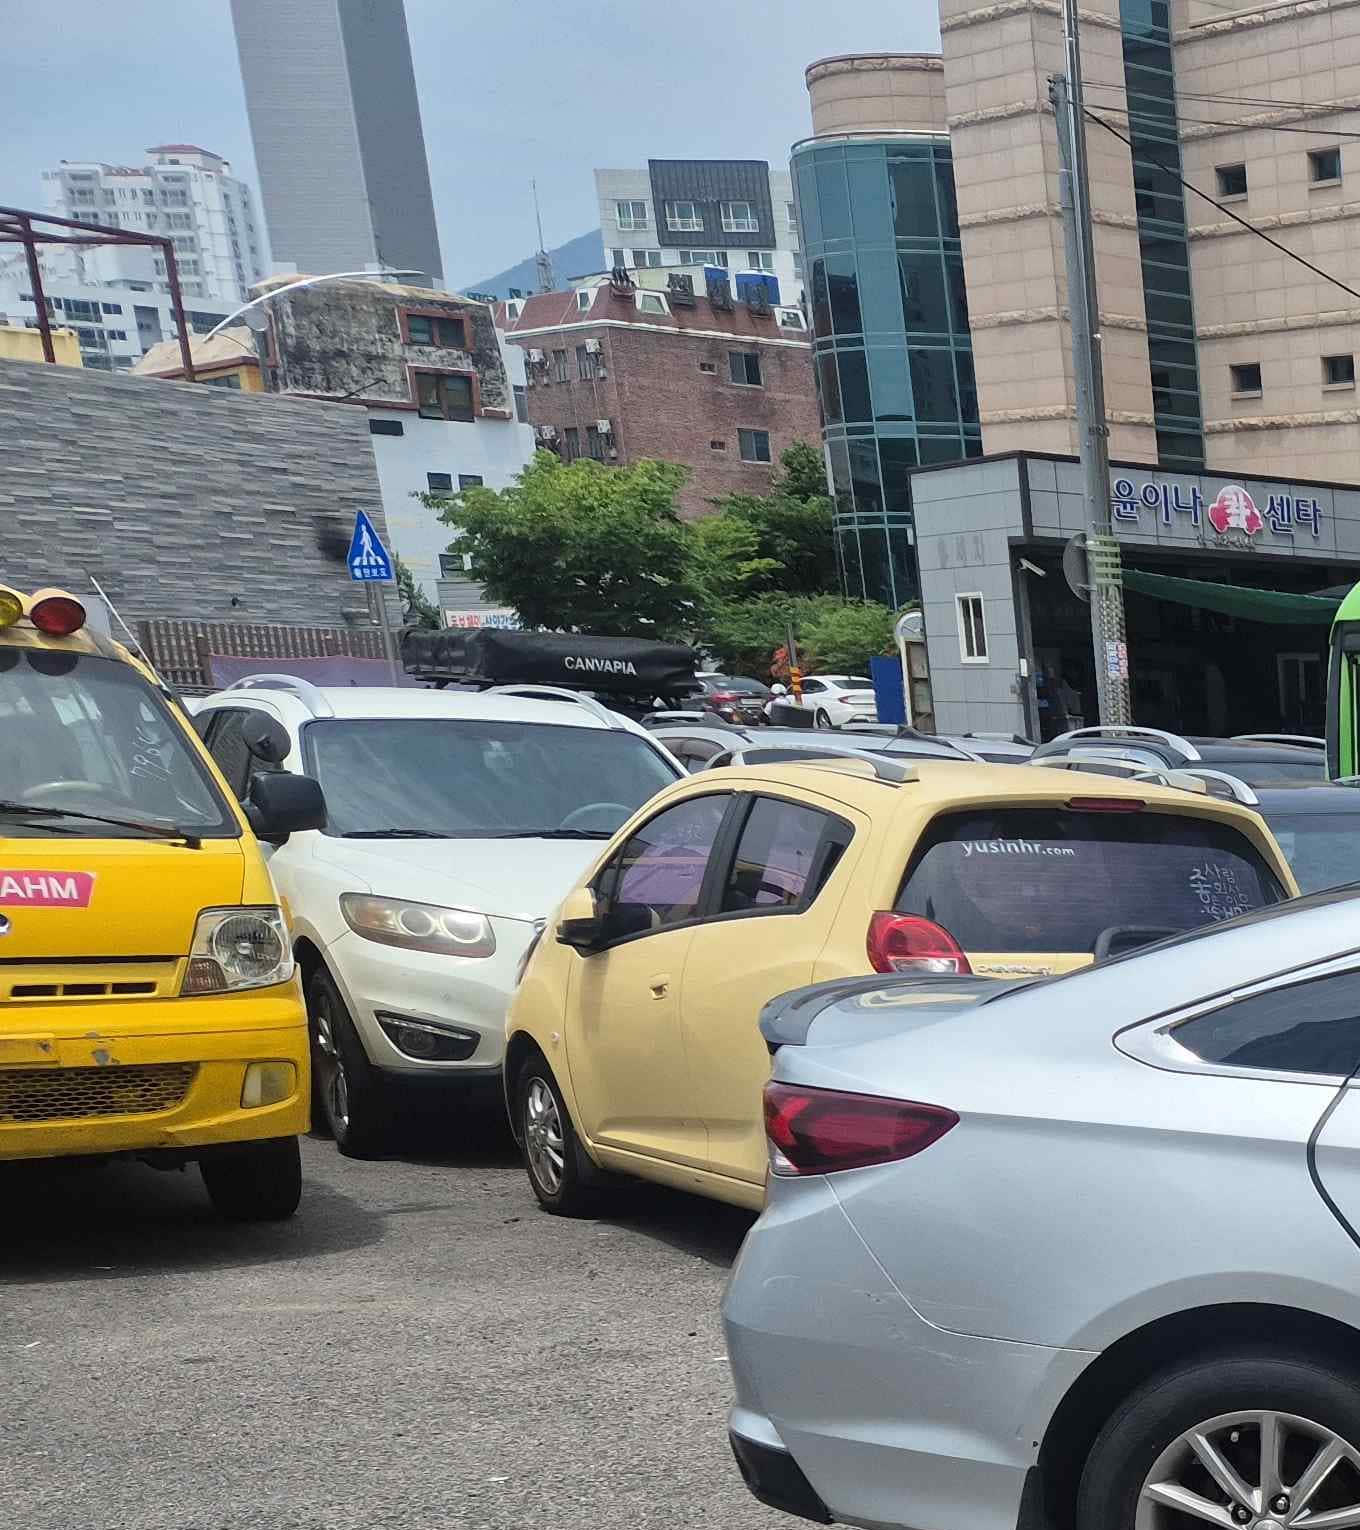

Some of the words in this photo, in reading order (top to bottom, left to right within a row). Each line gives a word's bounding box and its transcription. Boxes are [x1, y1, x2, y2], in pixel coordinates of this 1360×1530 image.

[1111, 479, 1203, 526] 윤이나
[1264, 495, 1322, 536] 센타
[564, 656, 637, 675] CANVAPIA
[961, 838, 1075, 857] yusinhr.com
